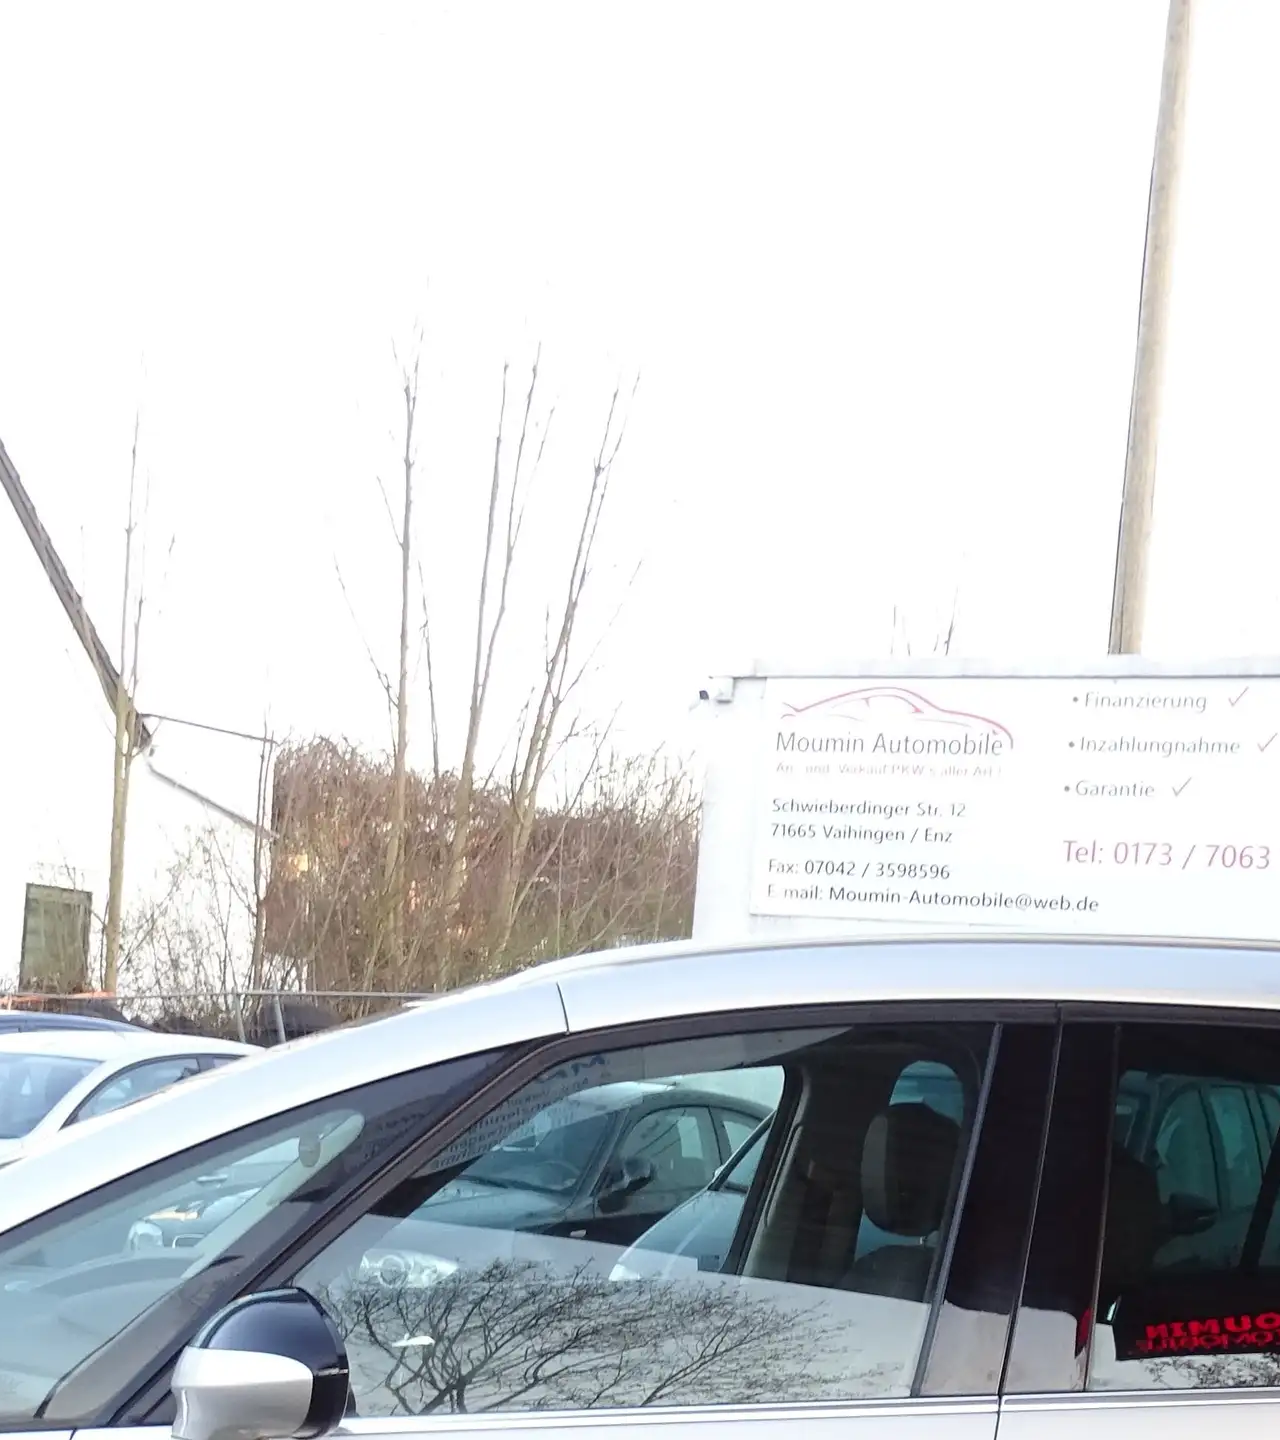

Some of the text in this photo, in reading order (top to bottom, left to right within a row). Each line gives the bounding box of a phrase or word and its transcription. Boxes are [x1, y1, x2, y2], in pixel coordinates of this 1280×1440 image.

[1084, 691, 1208, 713] Finanzierung
[776, 731, 1003, 756] Moumin Automobile
[1080, 736, 1240, 757] Inzahlungnahme
[1075, 780, 1155, 798] Garantie
[772, 799, 966, 820] Schwieberdinger Str. 12
[771, 823, 952, 845] 71665 Vaihingen / Enz
[1063, 840, 1103, 864] Tel:
[1114, 842, 1172, 866] 0173
[1182, 845, 1196, 870] /
[1205, 845, 1270, 870] 7063
[768, 859, 951, 880] Fax: 07042 / 3598596
[768, 884, 823, 900] Email:
